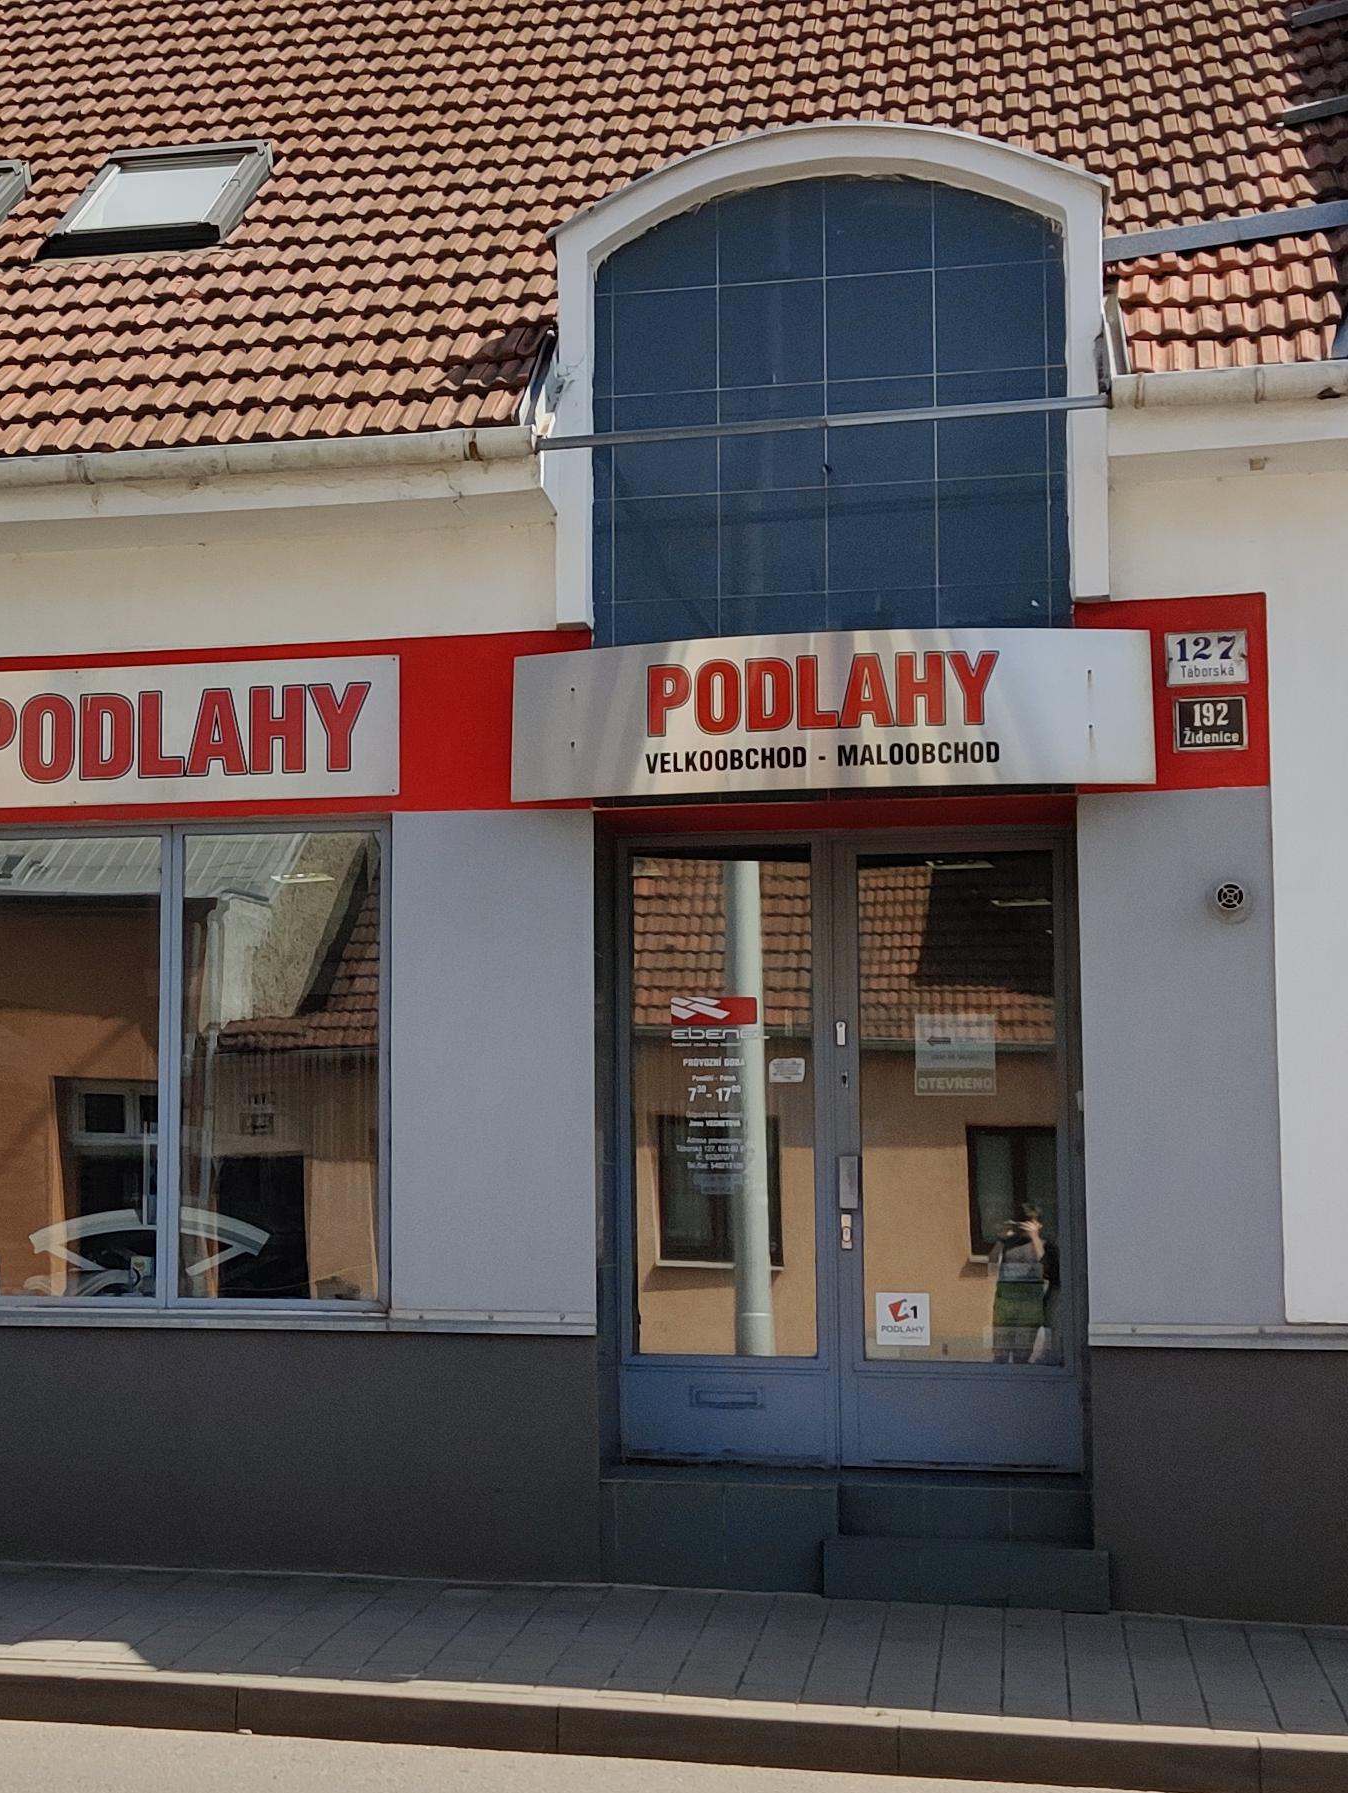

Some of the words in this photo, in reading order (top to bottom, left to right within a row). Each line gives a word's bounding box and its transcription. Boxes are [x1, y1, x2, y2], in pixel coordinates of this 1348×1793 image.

[1176, 635, 1236, 662] 127
[647, 650, 1000, 738] PODLAHY
[1193, 702, 1229, 727] 192
[1182, 727, 1240, 745] Židenice
[645, 746, 807, 774] VELKOOBCHOD
[837, 741, 1001, 767] MALOOBCHOD
[881, 1325, 925, 1334] PODLAHY
